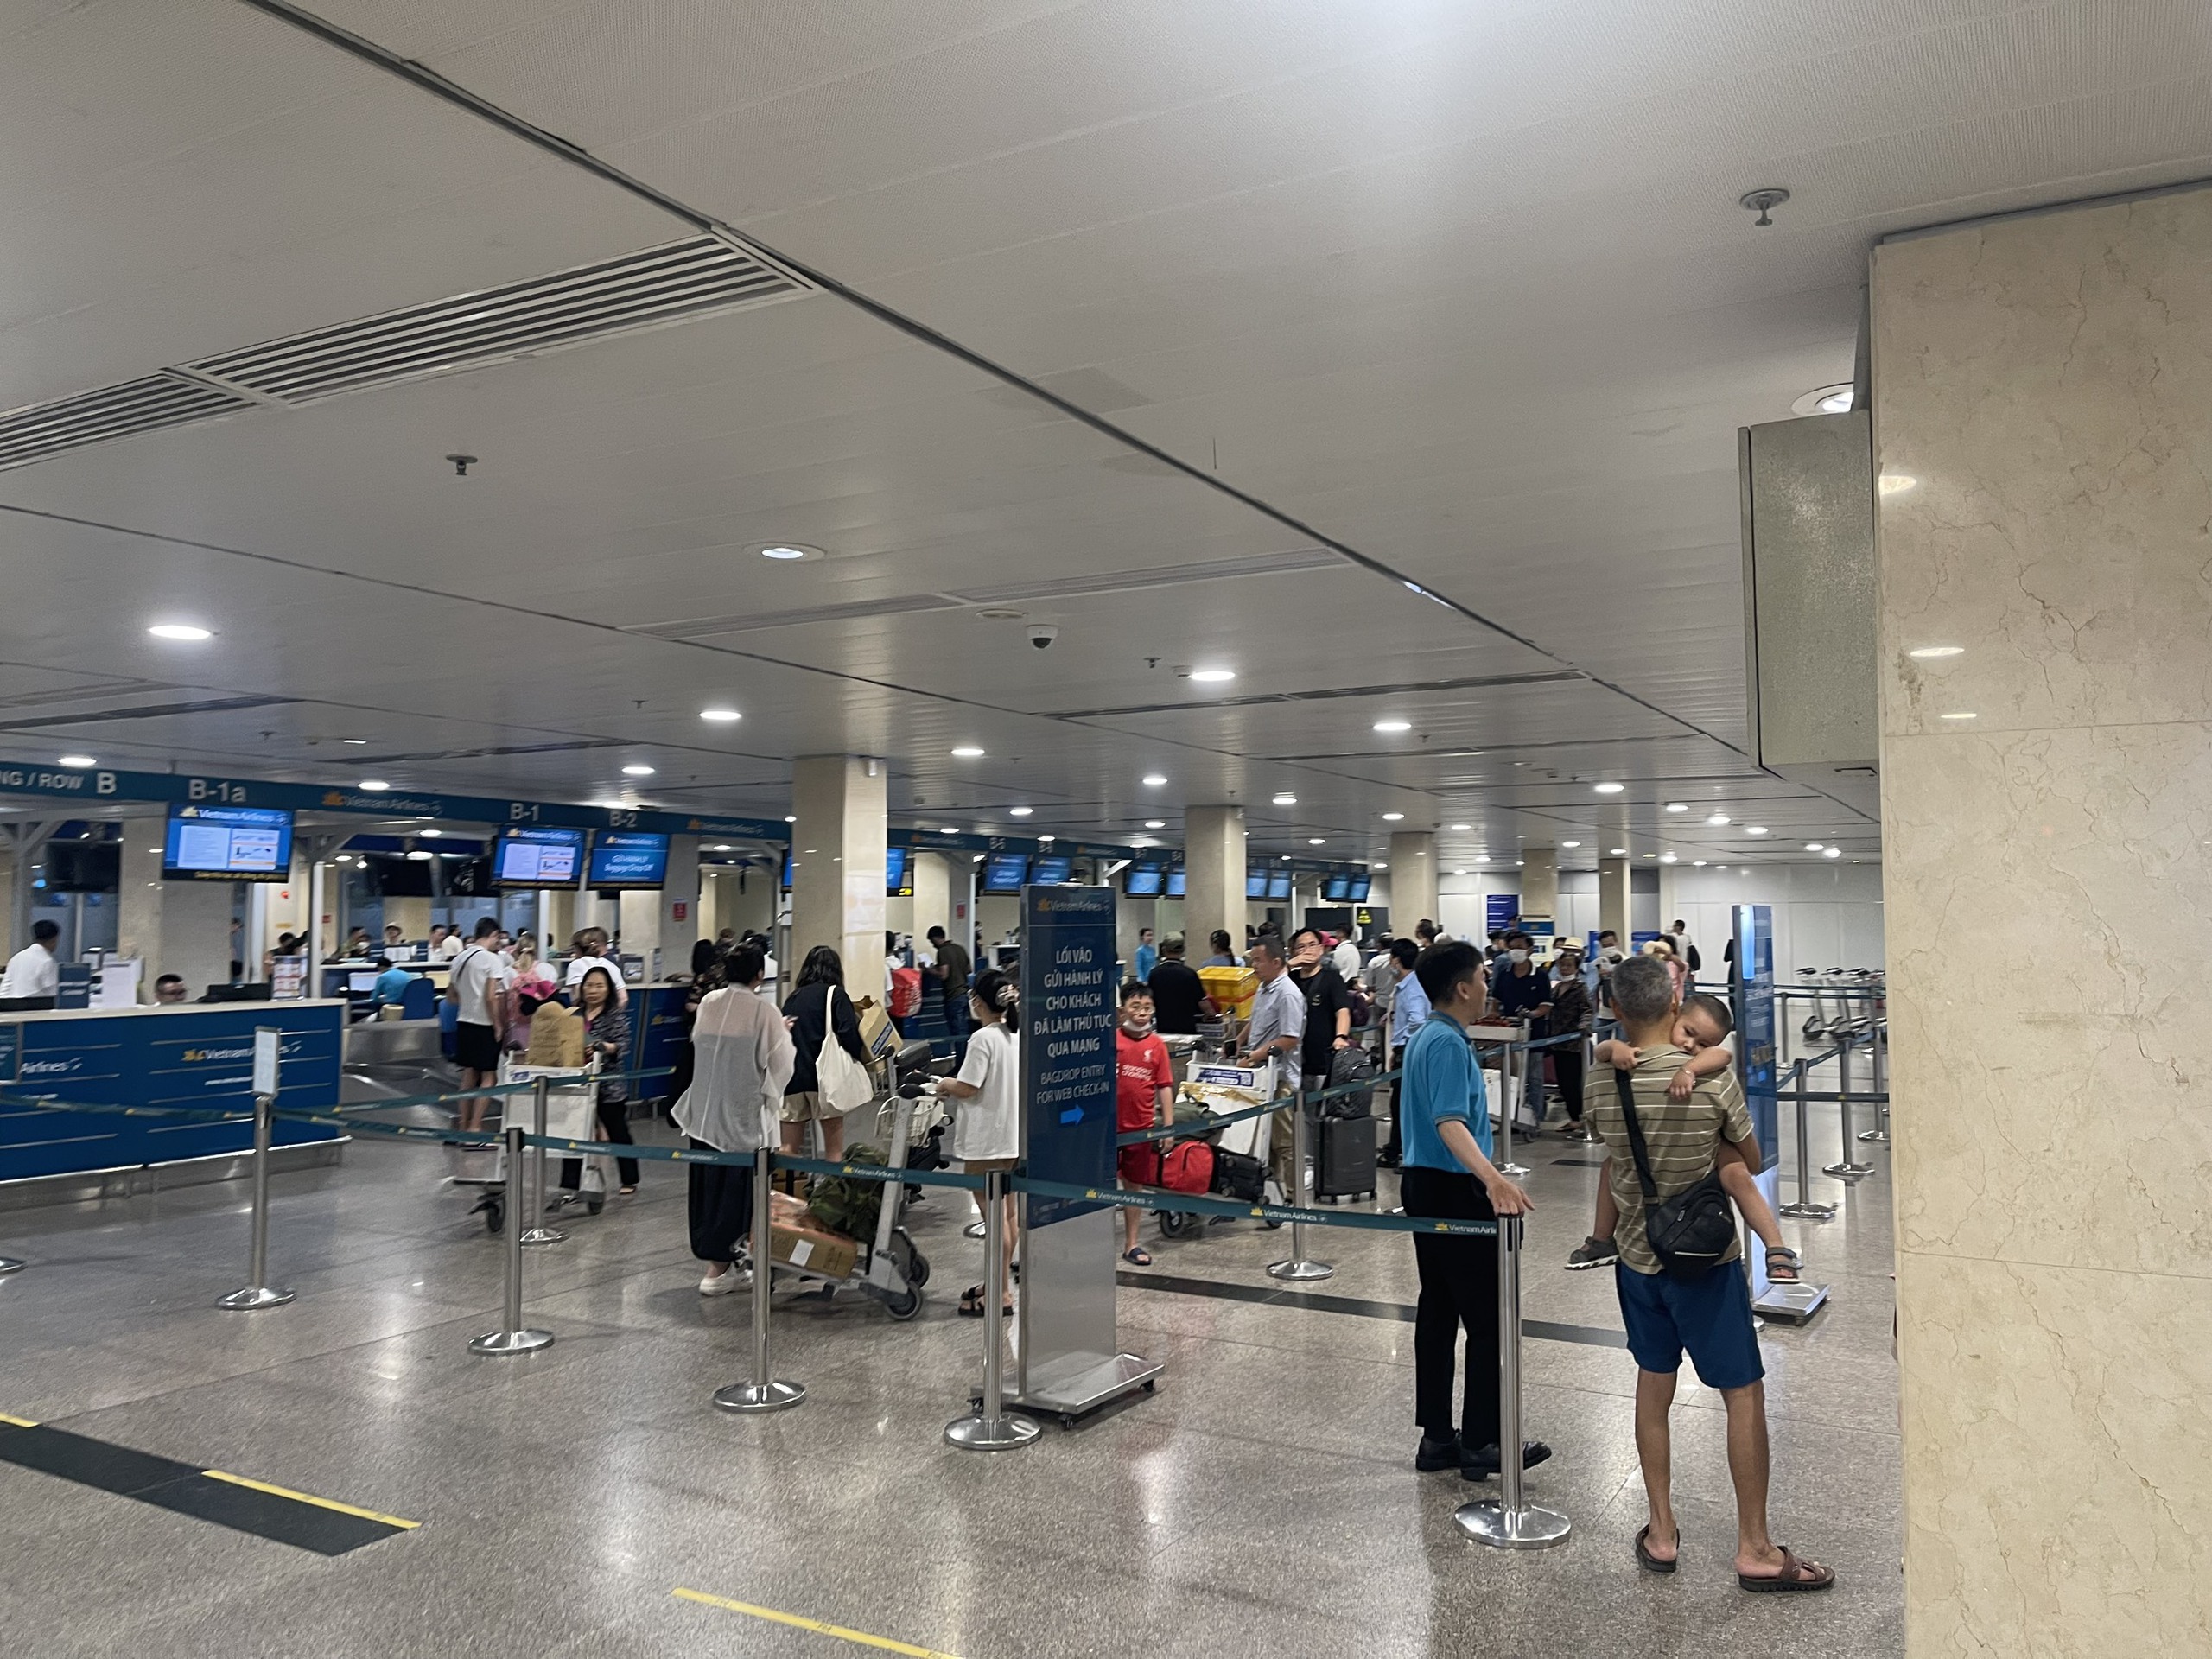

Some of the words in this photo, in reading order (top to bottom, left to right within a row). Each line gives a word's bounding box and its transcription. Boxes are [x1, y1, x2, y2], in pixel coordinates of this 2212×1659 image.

[38, 773, 85, 789] ROW
[97, 772, 117, 794] B
[188, 779, 247, 803] B-1a
[510, 803, 540, 821] B-1
[609, 810, 638, 828] B-2
[1072, 946, 1092, 963] VÀO
[1064, 969, 1092, 987] HÀNH
[1092, 968, 1103, 984] LÝ
[1046, 995, 1068, 1011] CHO
[1069, 991, 1102, 1009] KHÁCH
[1051, 1015, 1072, 1034] LÀM
[1093, 1014, 1112, 1031] TỤC
[1047, 1039, 1070, 1058] QUA
[1071, 1037, 1100, 1057] MẠNG
[1040, 1067, 1081, 1085] BAGDROP
[1081, 1064, 1107, 1079] ENTRY
[1037, 1090, 1054, 1104] FOR
[1053, 1087, 1073, 1102] WEB
[1073, 1081, 1110, 1099] CHECK-IN
[1263, 1210, 1292, 1219] Vietnam
[1479, 1226, 1497, 1235] Airli
